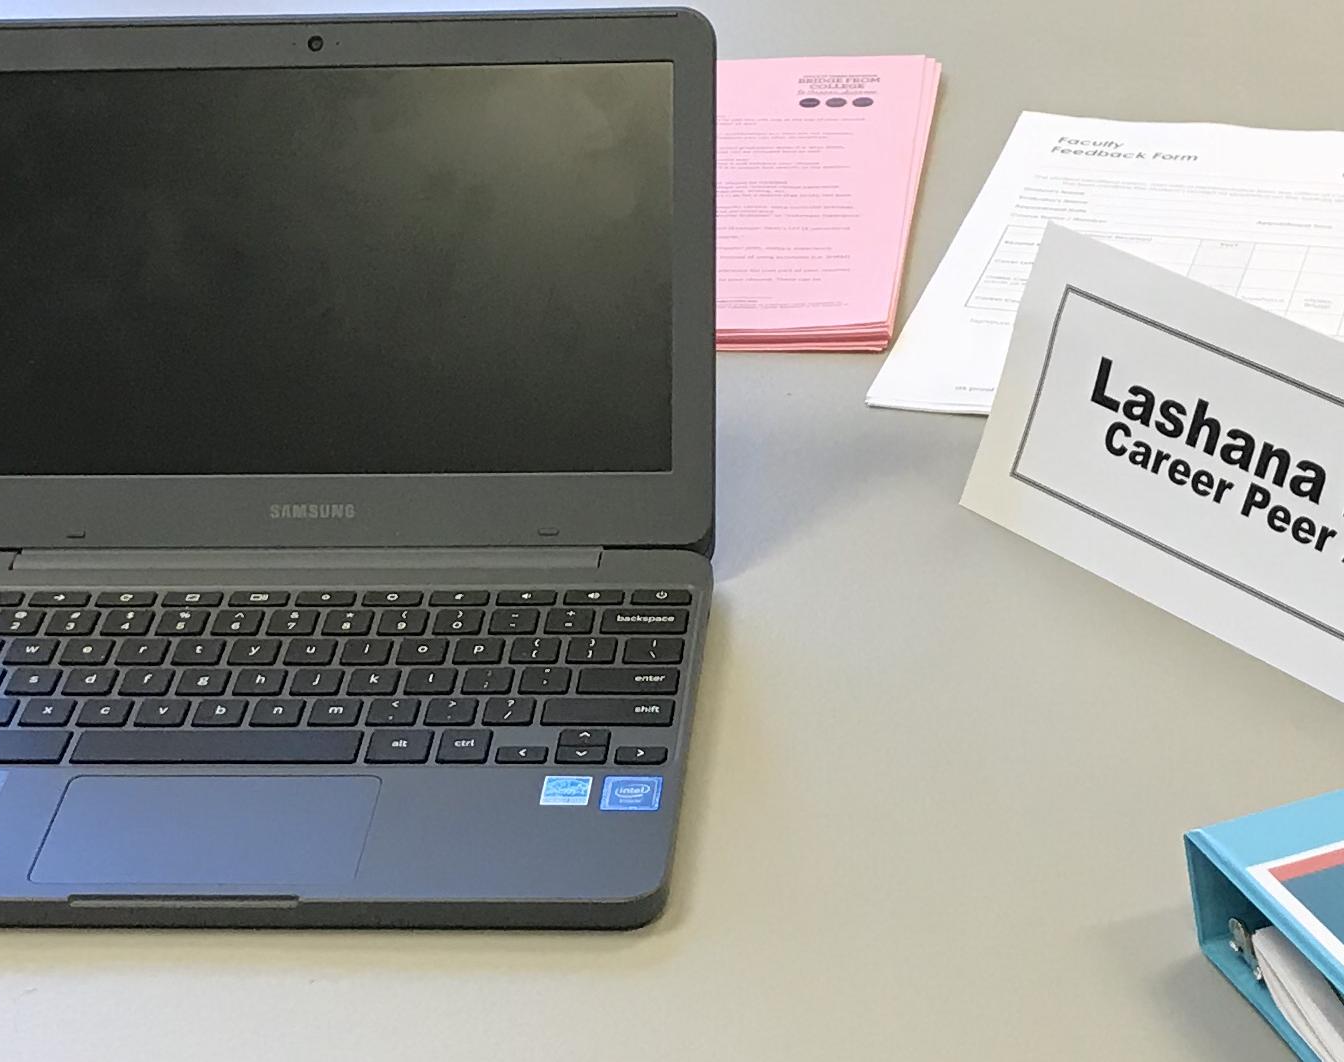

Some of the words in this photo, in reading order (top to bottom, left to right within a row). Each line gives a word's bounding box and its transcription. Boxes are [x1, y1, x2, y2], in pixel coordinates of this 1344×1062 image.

[1057, 136, 1125, 149] Faculty
[1050, 146, 1147, 160] Feedback
[1151, 151, 1199, 161] Form
[1090, 355, 1327, 505] Lashana
[1104, 420, 1235, 504] Career
[1240, 481, 1338, 552] Peer
[270, 503, 356, 518] SAMSUNG
[617, 615, 674, 623] backspace
[618, 784, 649, 794] intel
